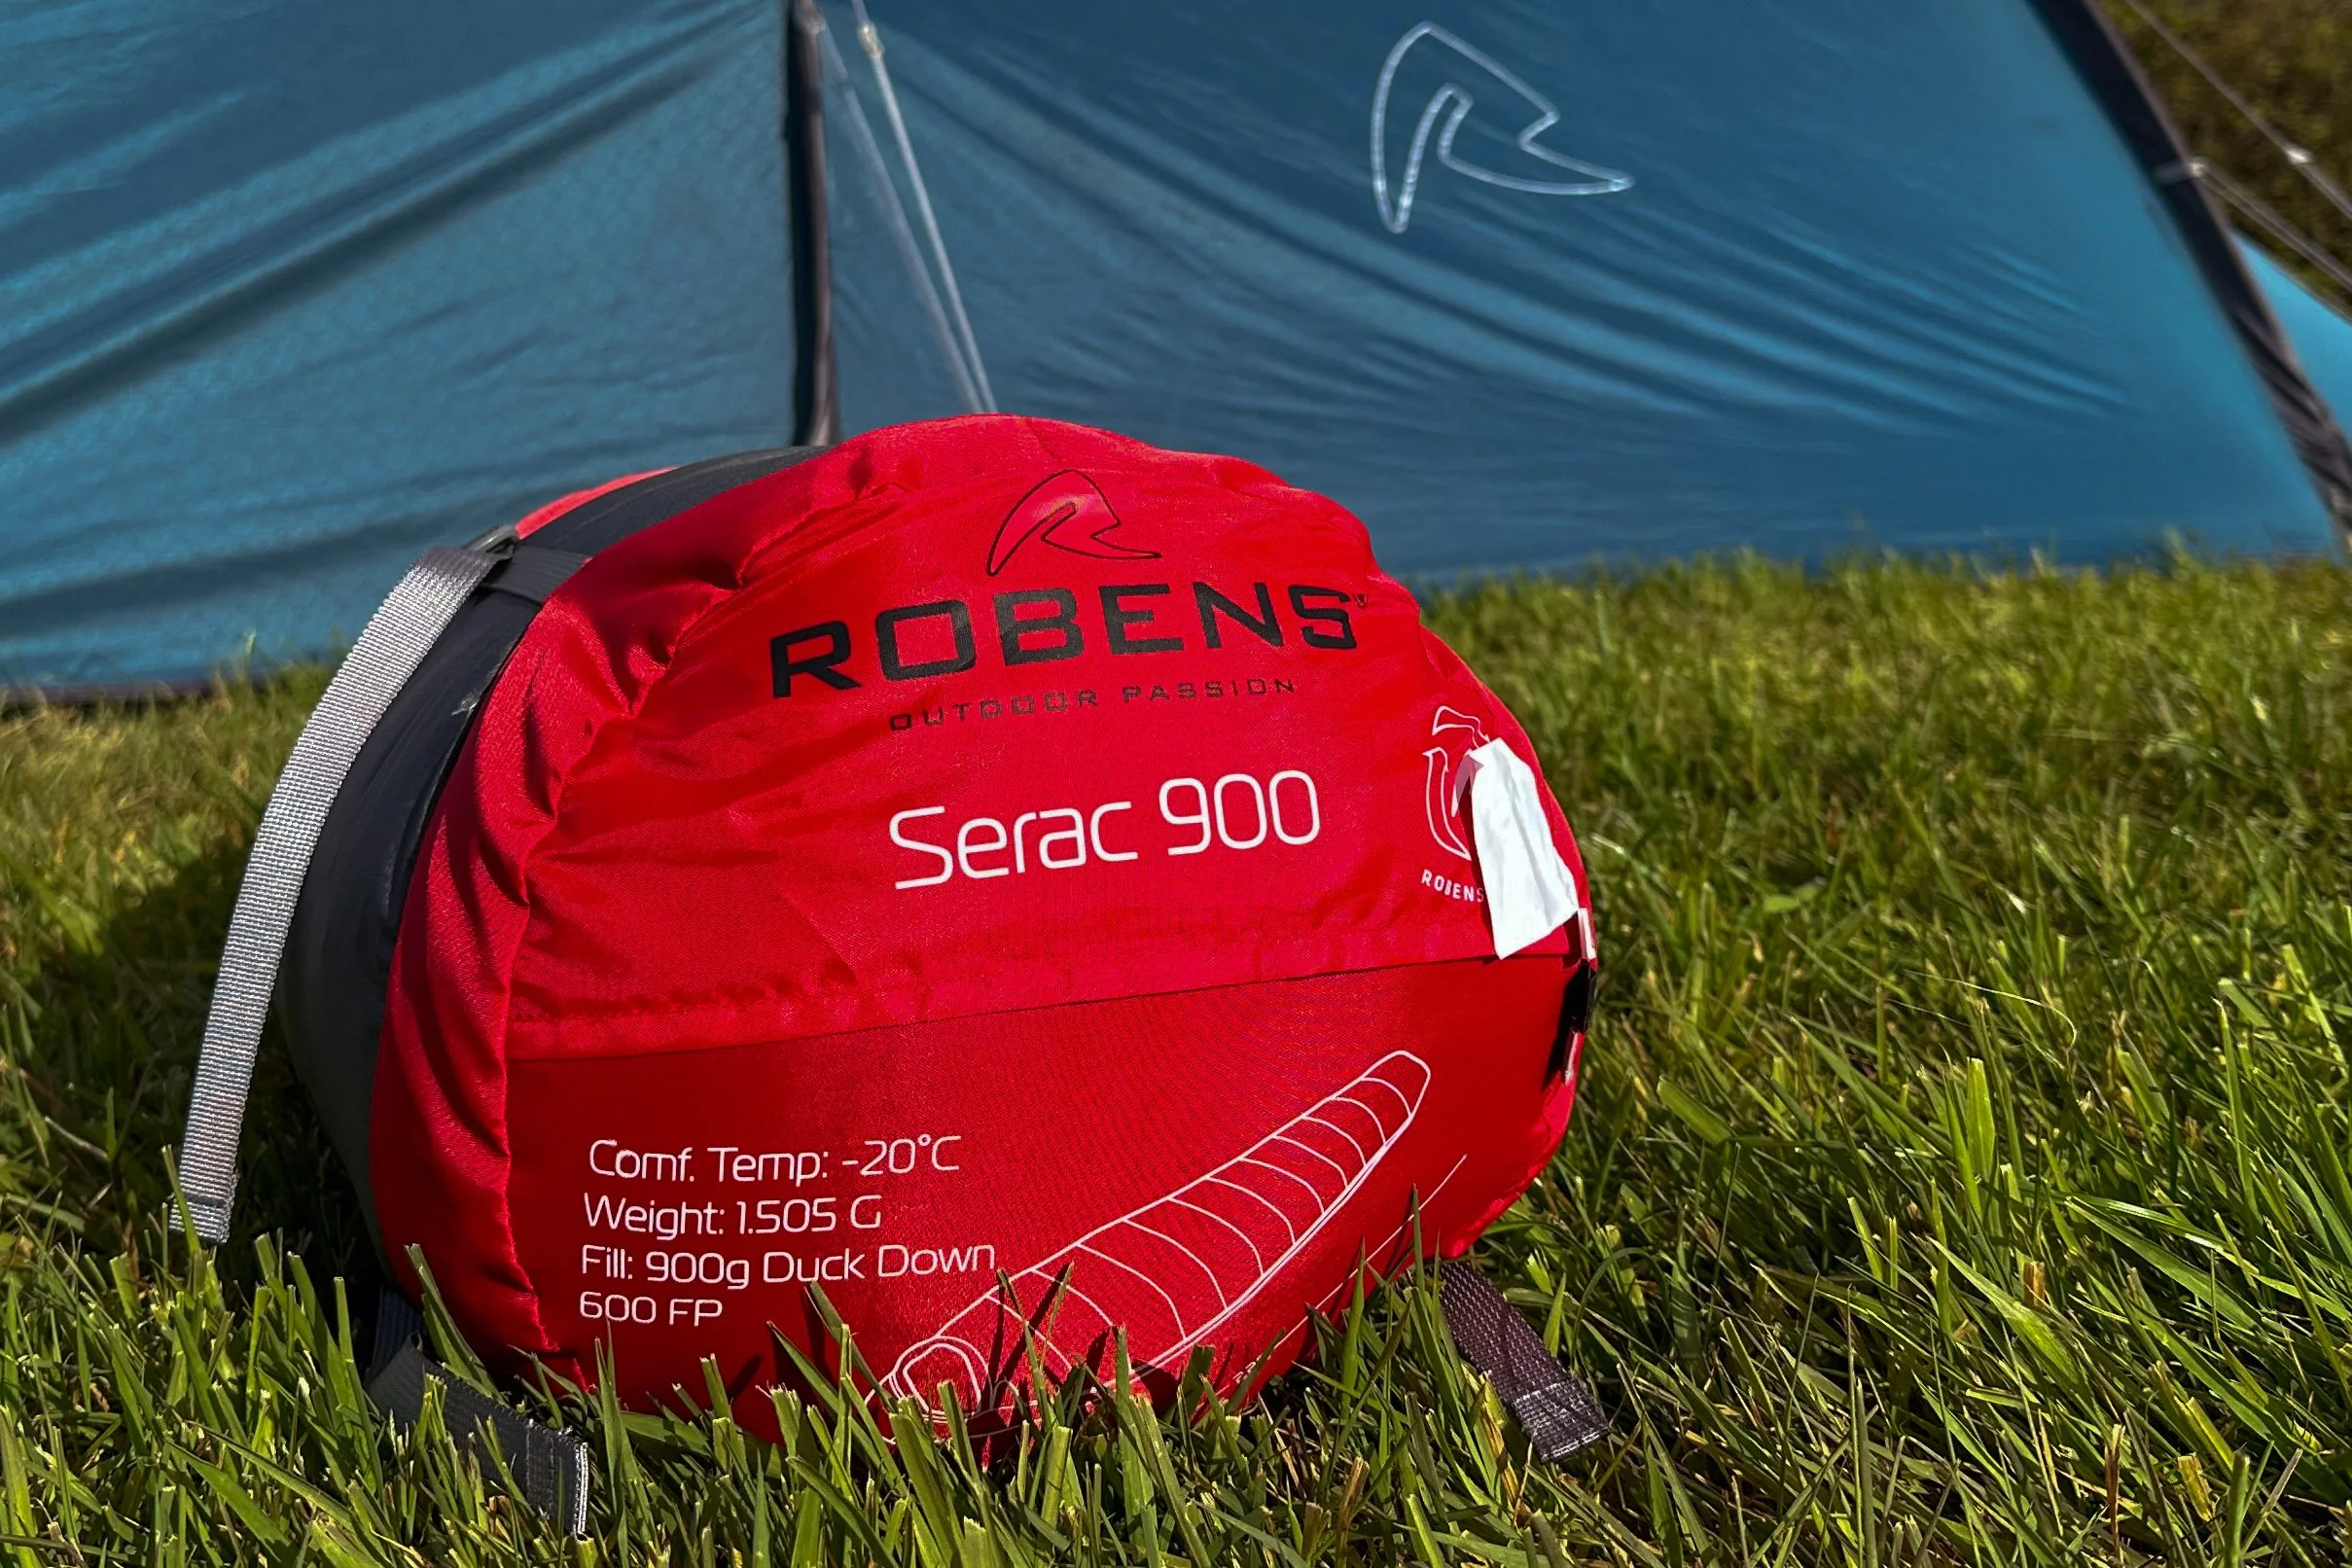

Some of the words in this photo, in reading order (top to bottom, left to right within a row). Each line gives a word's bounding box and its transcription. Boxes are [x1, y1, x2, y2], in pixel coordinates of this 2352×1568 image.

[769, 582, 1358, 698] ROBENS
[889, 688, 1098, 731] OUTDOOR
[1123, 677, 1296, 704] PASSION
[889, 801, 1139, 889] Serac
[1158, 769, 1321, 856] 900
[588, 1139, 696, 1182] Comf.
[707, 1147, 829, 1187] Temp:
[841, 1133, 962, 1176] -20°C
[584, 1193, 726, 1241] Weight:
[736, 1196, 837, 1235] 1.505
[849, 1194, 883, 1229] G
[581, 1244, 634, 1280] Fill:
[646, 1251, 750, 1290] 900g
[763, 1248, 867, 1283] Duck
[878, 1244, 996, 1277] Down
[579, 1291, 657, 1325] 600
[669, 1299, 724, 1327] FP
